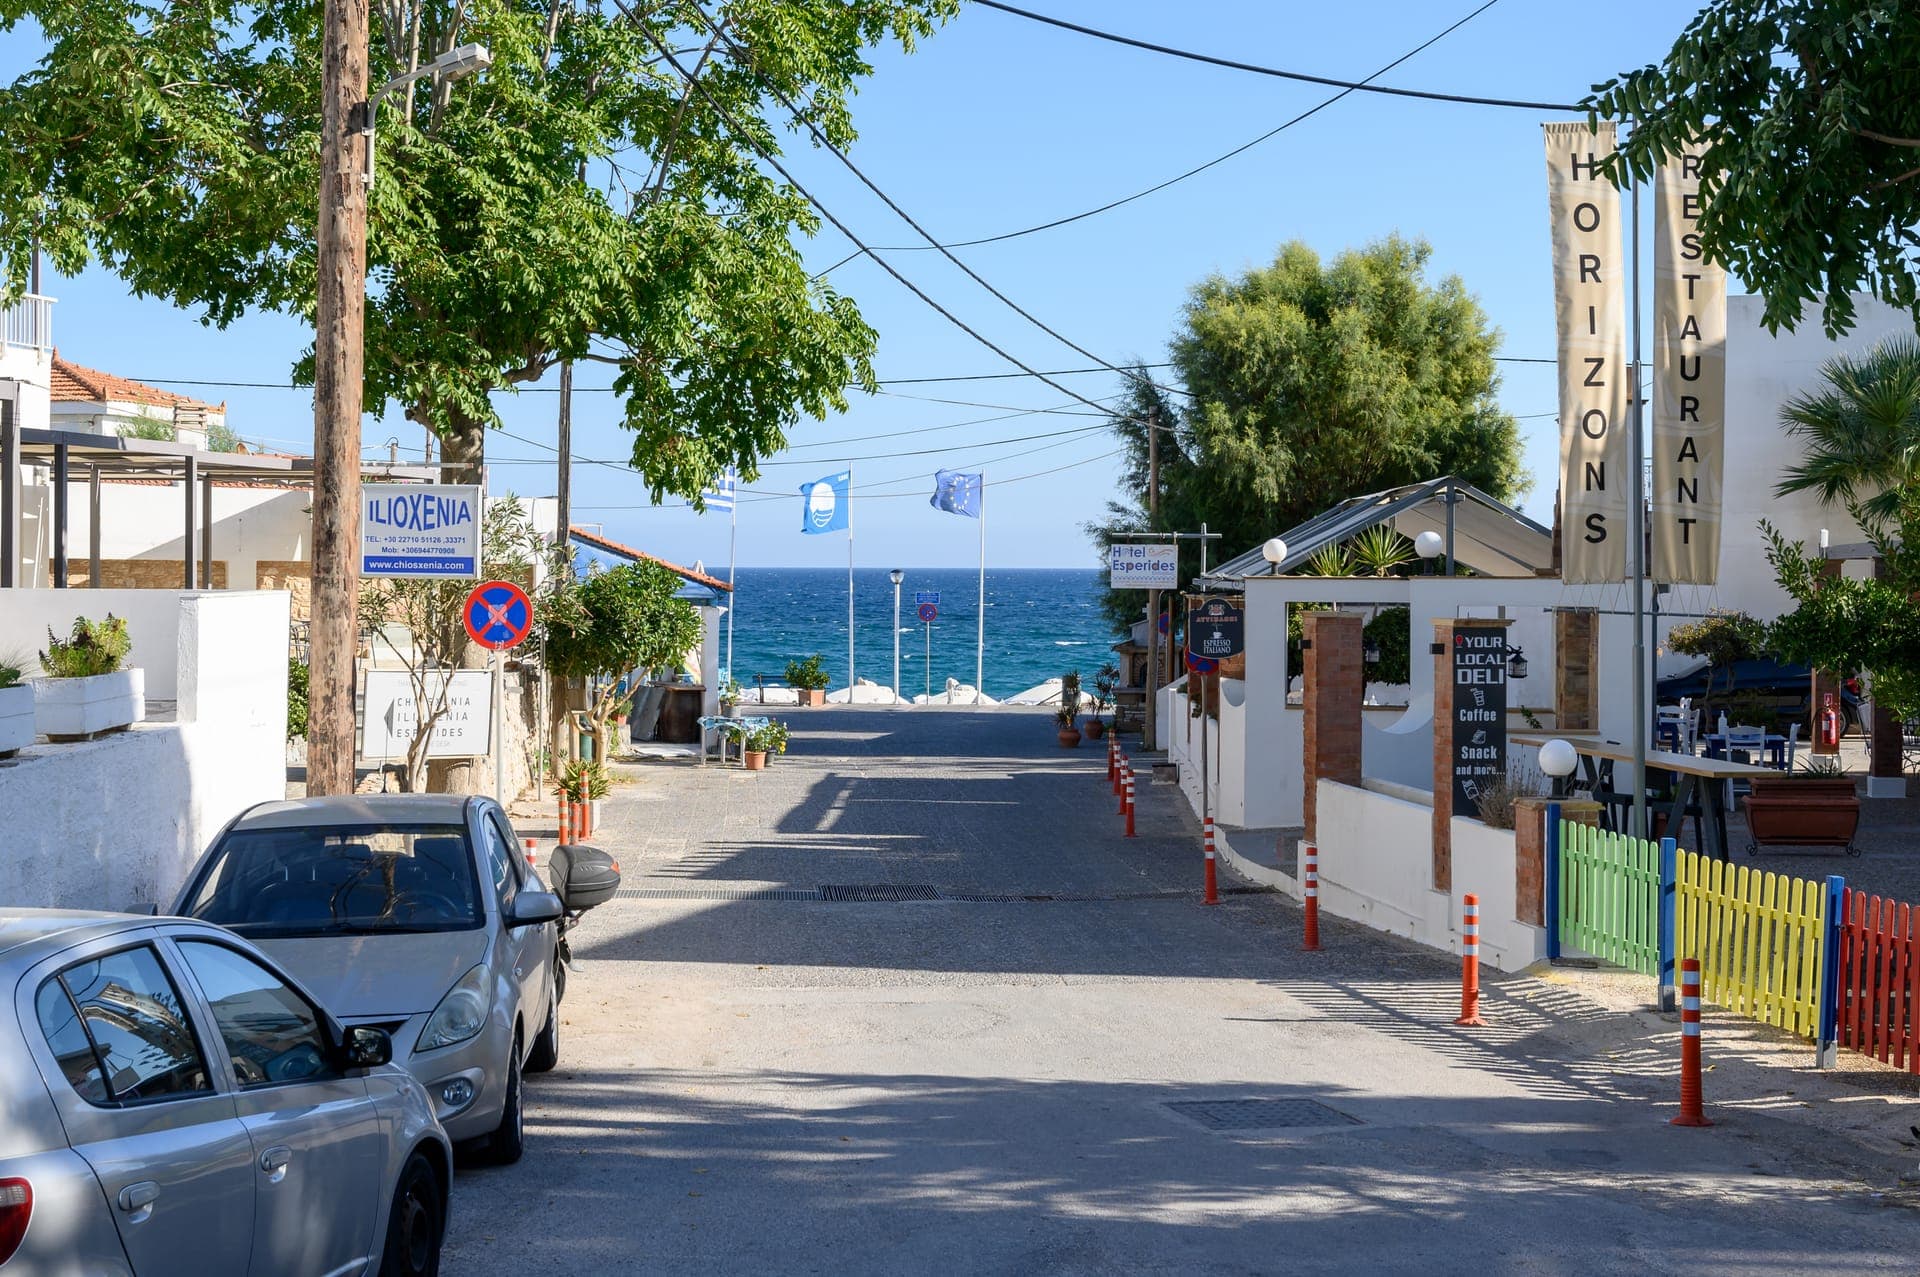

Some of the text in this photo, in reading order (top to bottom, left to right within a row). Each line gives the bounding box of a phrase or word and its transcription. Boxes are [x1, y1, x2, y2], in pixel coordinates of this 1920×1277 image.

[1571, 153, 1607, 544] HORIZONS
[1677, 154, 1702, 544] RESTAURANT
[369, 494, 471, 531] ILIOXENIA
[382, 546, 398, 554] Mob:
[1113, 546, 1146, 558] Htel
[369, 560, 465, 570] www.chiosxenia.com
[1112, 559, 1175, 573] Esperides
[1203, 639, 1231, 647] ESPRESSO
[1465, 636, 1502, 648] YOUR
[1203, 646, 1231, 654] ITALIANO
[1456, 654, 1505, 665] LOCAL
[1457, 668, 1504, 684] DELI
[1459, 708, 1497, 721] Coffee
[396, 728, 463, 738] ESPIDES
[1461, 745, 1497, 759] Snack
[1456, 764, 1505, 775] and more...
